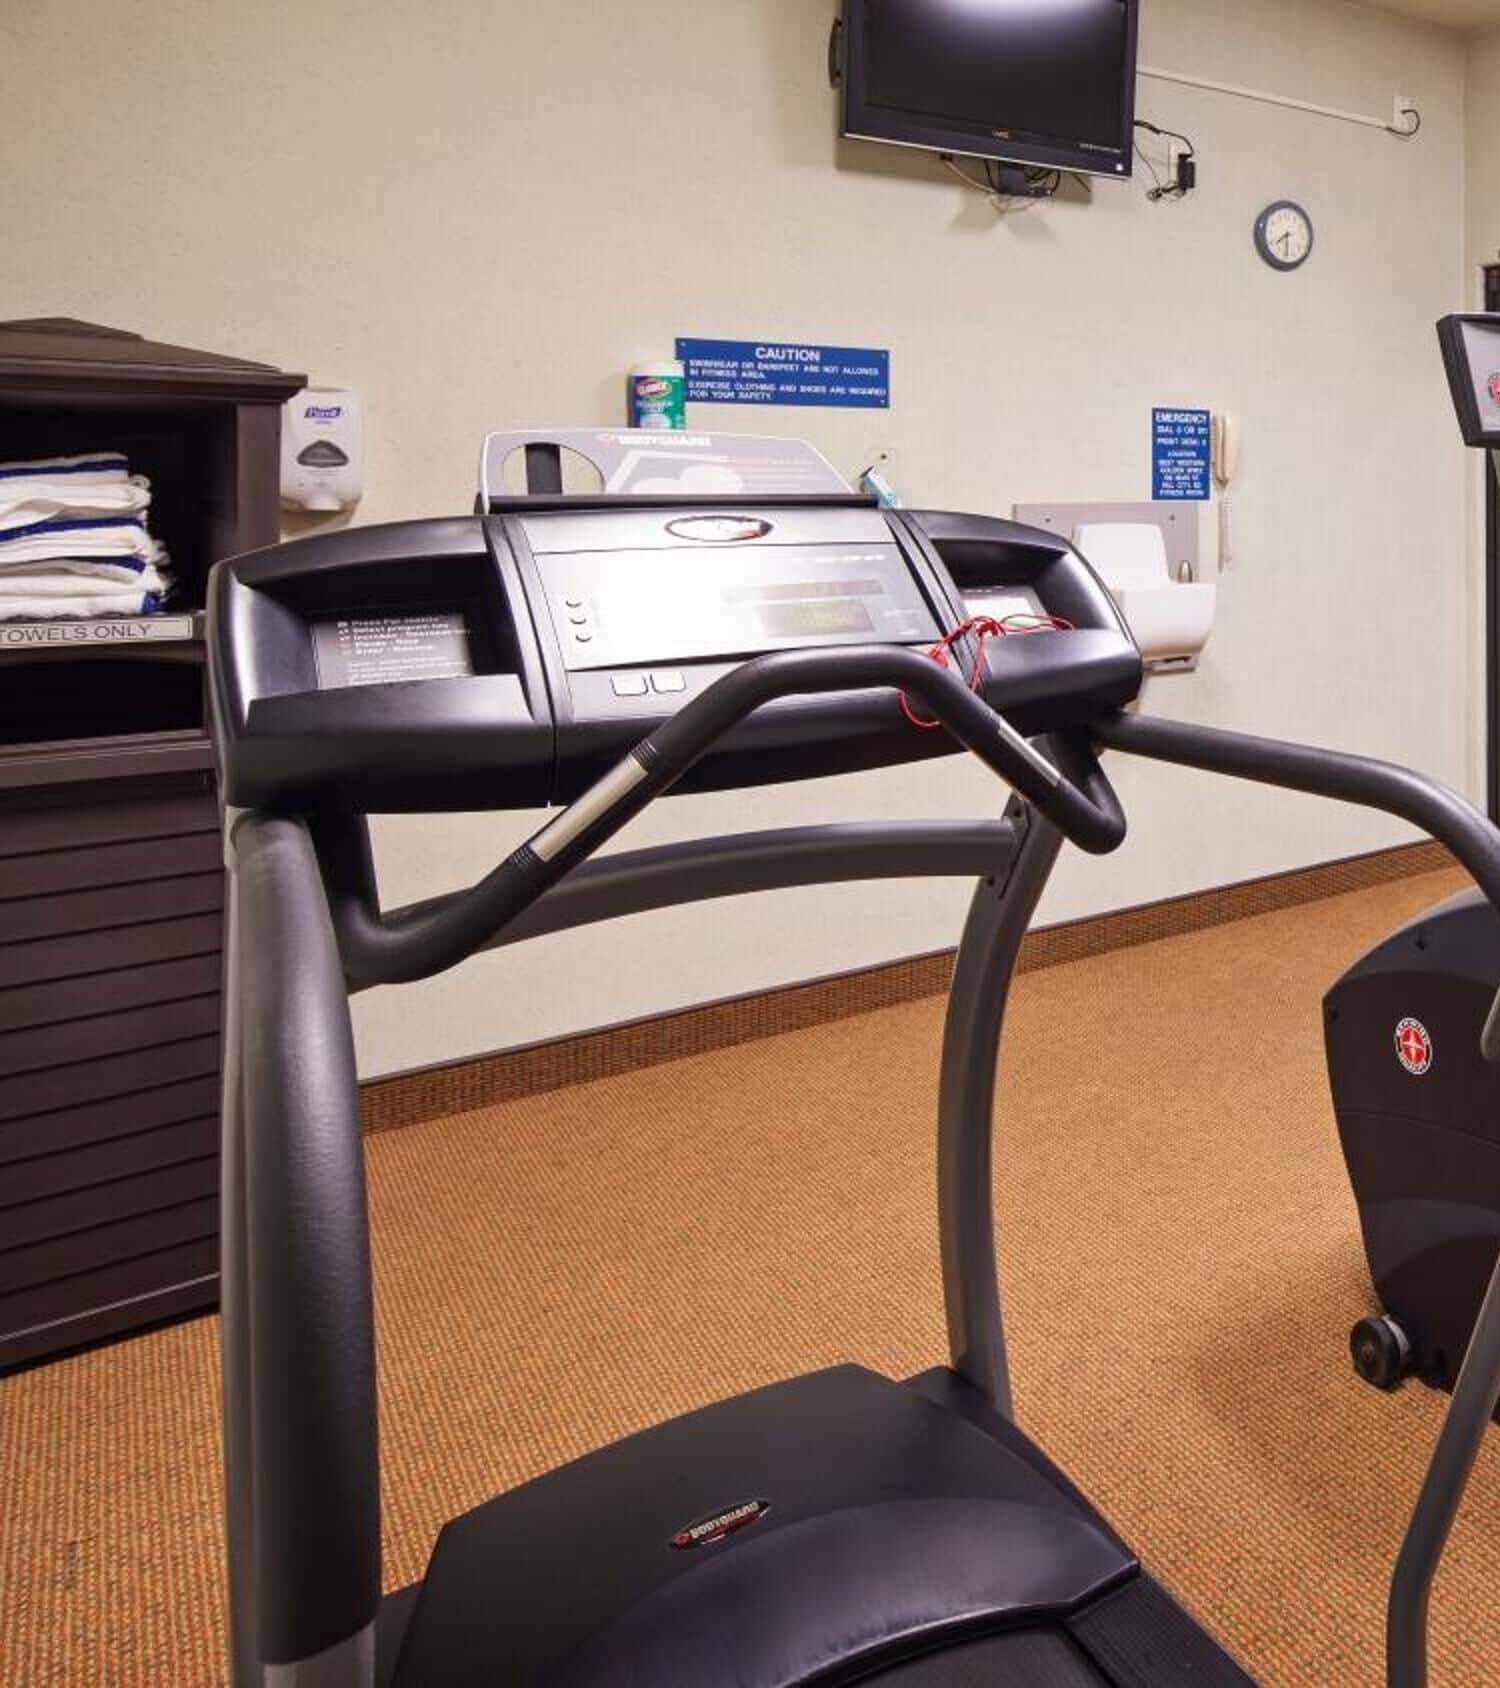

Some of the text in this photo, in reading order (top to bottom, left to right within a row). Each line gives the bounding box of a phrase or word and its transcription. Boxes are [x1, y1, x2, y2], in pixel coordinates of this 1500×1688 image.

[754, 347, 821, 361] CAUTION
[1155, 412, 1207, 424] EMERGENCY
[0, 623, 150, 642] TOWELS ONLY
